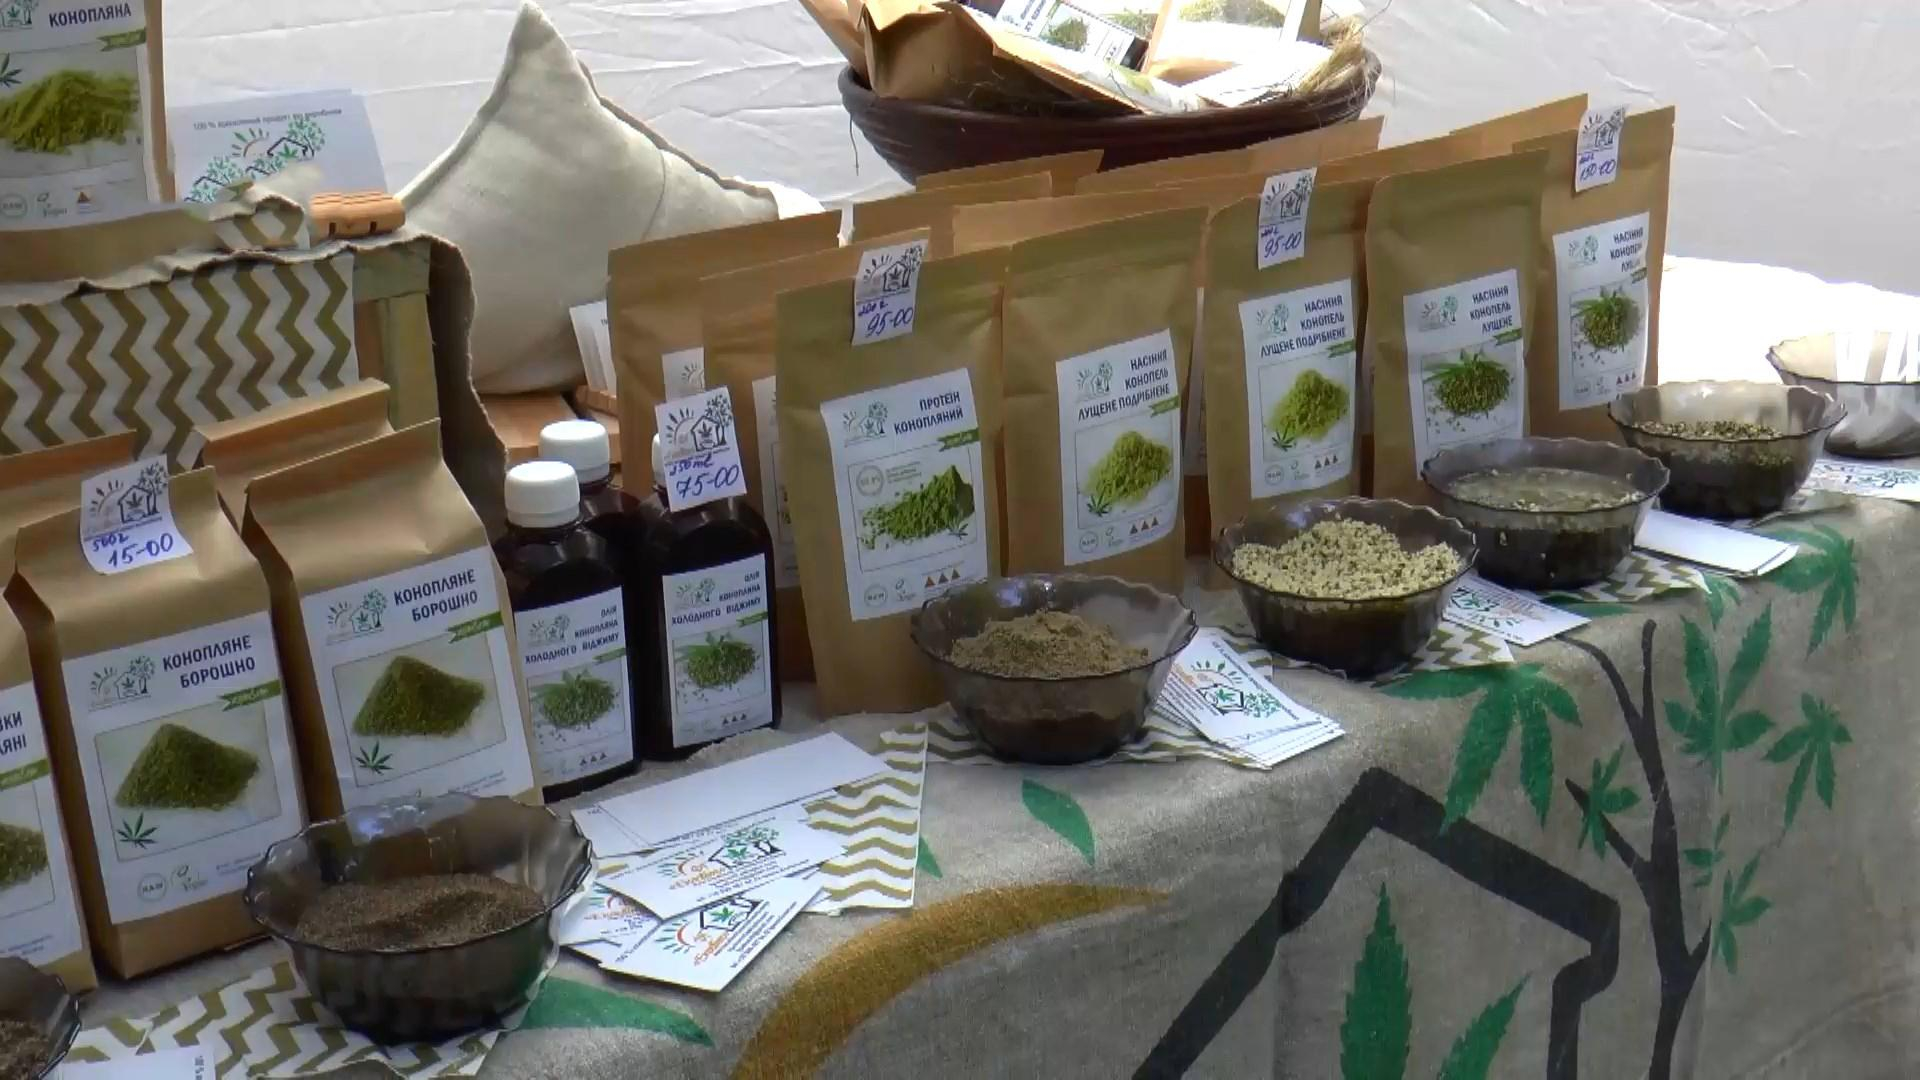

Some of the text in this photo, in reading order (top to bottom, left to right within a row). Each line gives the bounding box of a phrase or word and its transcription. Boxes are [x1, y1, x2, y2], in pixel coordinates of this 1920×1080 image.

[49, 3, 131, 28] КОНОПЛЯНА
[1305, 295, 1343, 313] НАСІННЯ
[1472, 285, 1509, 304] НАСІННЯ
[865, 307, 914, 338] 95-00
[1300, 312, 1344, 331] КОНОПЕЛЬ
[1470, 302, 1511, 320] КОНОПЕЛЬ
[1482, 315, 1513, 334] ЛУЩЕНЕ
[1130, 349, 1167, 371] НАСІННЯ
[1261, 338, 1294, 358] ЛУЩЕНЕ
[1125, 367, 1169, 390] КОНОПЕЛЬ
[1078, 383, 1170, 421] ЛУЩЕНЕ ПОДРІБНЕНЕ
[894, 406, 964, 435] КОНОПЛЯНИЙ
[676, 464, 740, 499] 75-00
[108, 533, 174, 567] 15-00
[394, 569, 476, 606] КОНОПЛЯНЕ
[719, 584, 761, 602] КОНОПЛЯНА
[412, 591, 478, 622] БОРОШНО
[600, 605, 617, 618] ОЛІЯ
[672, 597, 761, 626] ХОЛОДНОГО ВІДЖИМУ
[574, 620, 618, 639] КОНОПЛЯНА
[162, 635, 252, 672] КОНОПЛЯНЕ
[525, 632, 620, 664] ХОЛОДНОГО ВІДЖИМУ
[180, 657, 256, 689] БОРОШНО
